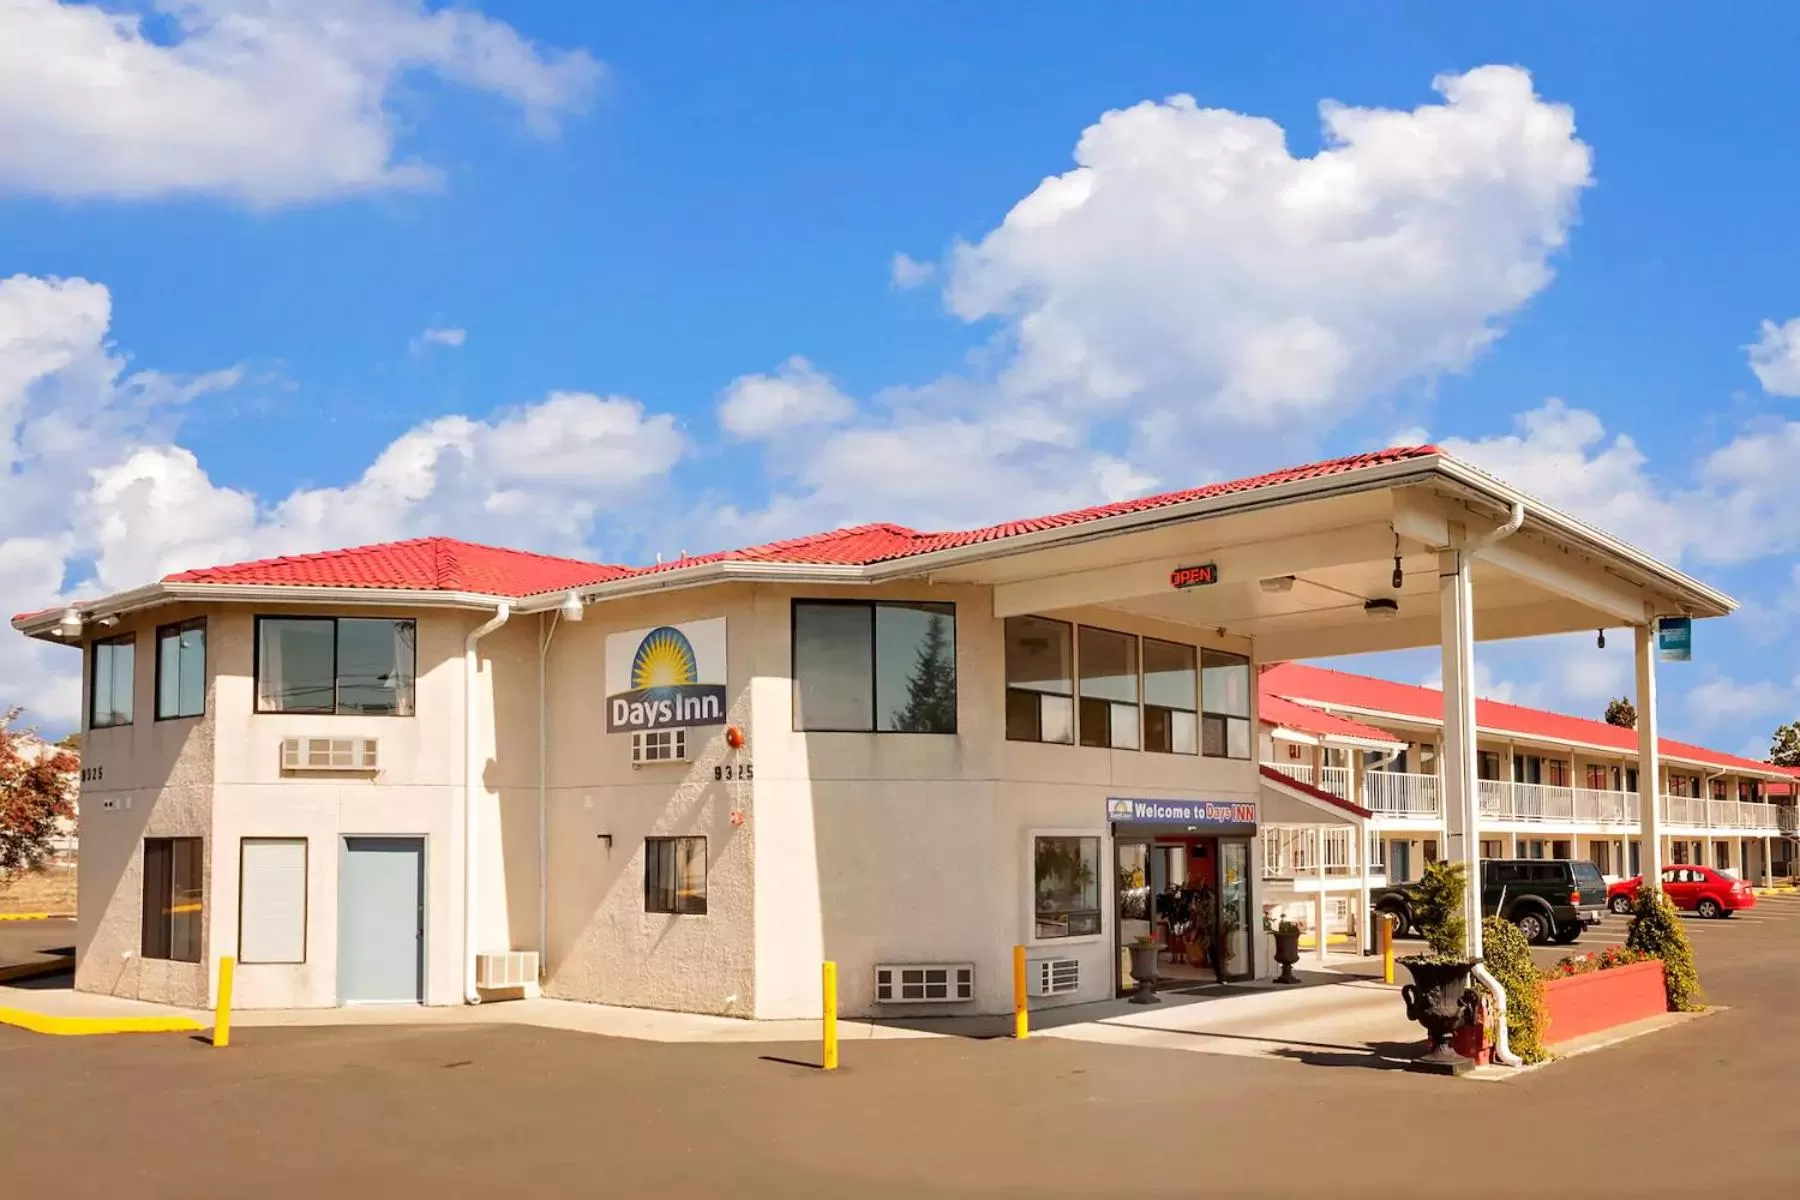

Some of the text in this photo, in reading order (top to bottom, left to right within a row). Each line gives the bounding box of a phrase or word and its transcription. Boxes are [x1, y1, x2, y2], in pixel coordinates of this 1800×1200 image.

[1169, 567, 1212, 586] OPEN
[612, 693, 719, 728] Days Inn
[714, 764, 754, 781] 9325
[1134, 803, 1190, 819] Welcome
[1194, 805, 1206, 819] to
[1206, 802, 1231, 823] Days
[1231, 803, 1255, 823] INN
